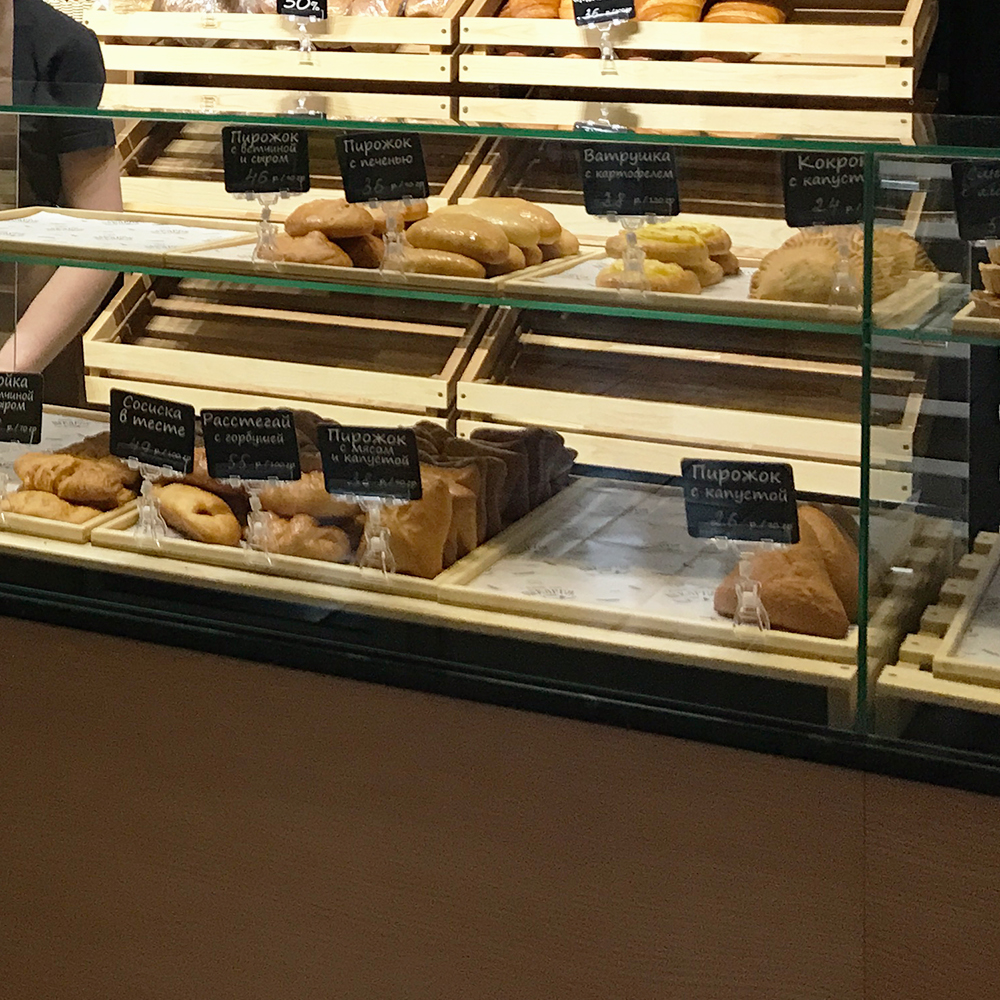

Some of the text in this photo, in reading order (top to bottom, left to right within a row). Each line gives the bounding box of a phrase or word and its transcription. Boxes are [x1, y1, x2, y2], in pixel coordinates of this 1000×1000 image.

[230, 141, 297, 154] с ветчиной
[231, 130, 299, 148] Пирожок
[343, 137, 413, 156] Пирожок
[240, 154, 289, 167] и сыром
[349, 154, 414, 169] с печенью
[583, 148, 671, 166] Ватрушка
[585, 167, 674, 181] с картофелем
[788, 177, 797, 187] с
[123, 395, 182, 420] Сосиска
[119, 408, 186, 437] в тесте
[202, 412, 291, 428] Расстегай
[214, 430, 284, 447] с горбушей
[327, 428, 407, 445] Пирожок
[340, 443, 394, 455] с мясом
[331, 453, 409, 467] и капустой
[692, 464, 782, 486] Пирожок
[690, 486, 788, 504] с капустой
